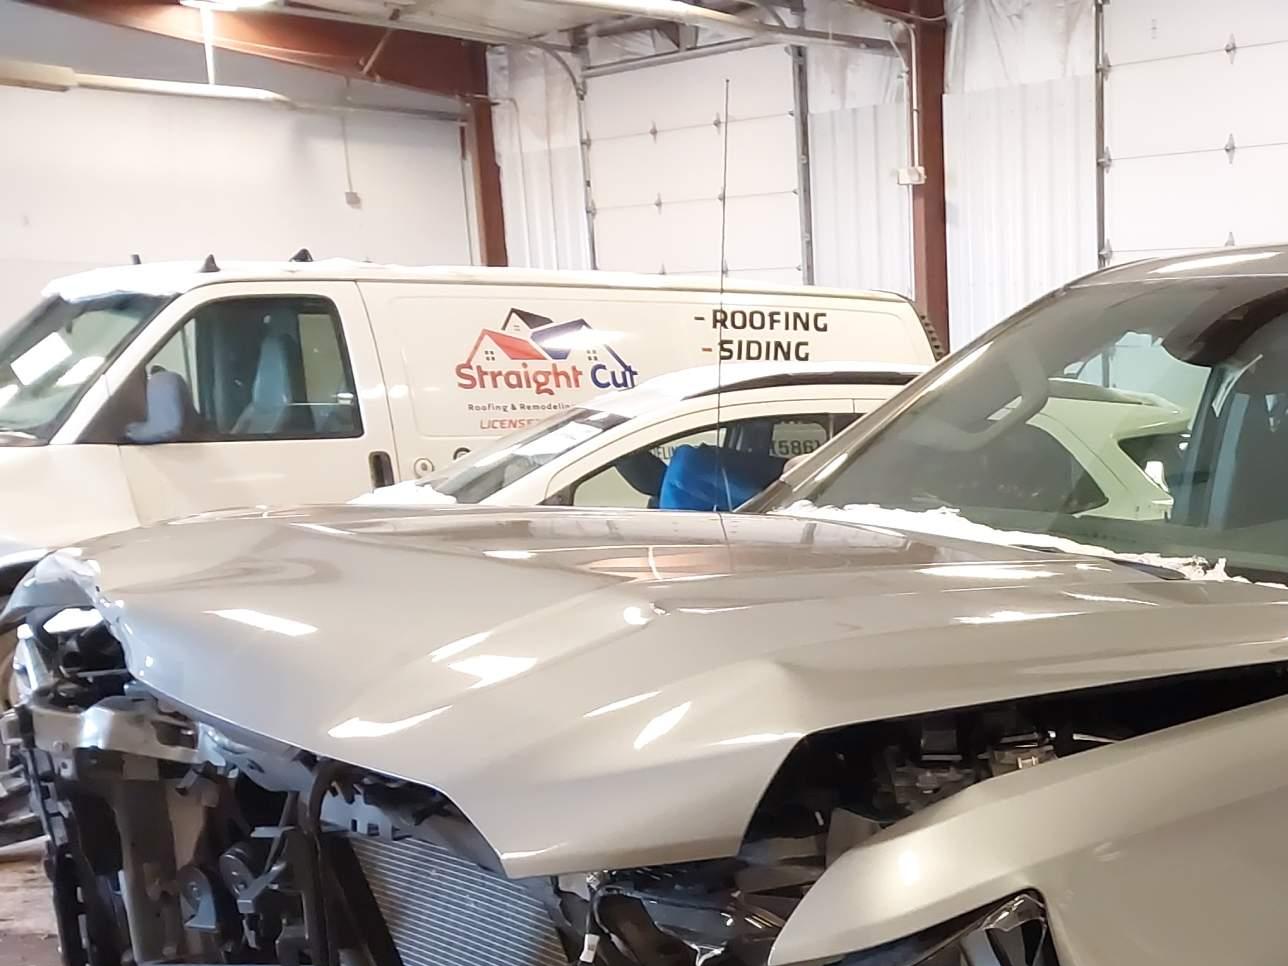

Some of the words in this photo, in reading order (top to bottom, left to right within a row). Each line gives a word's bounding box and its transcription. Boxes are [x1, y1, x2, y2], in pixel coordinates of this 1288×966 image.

[712, 309, 828, 332] ROOFING
[719, 339, 810, 362] SIDING
[455, 362, 583, 396] Straight
[590, 363, 639, 388] Cut
[468, 403, 508, 412] Roofing
[519, 402, 577, 411] Remodelin
